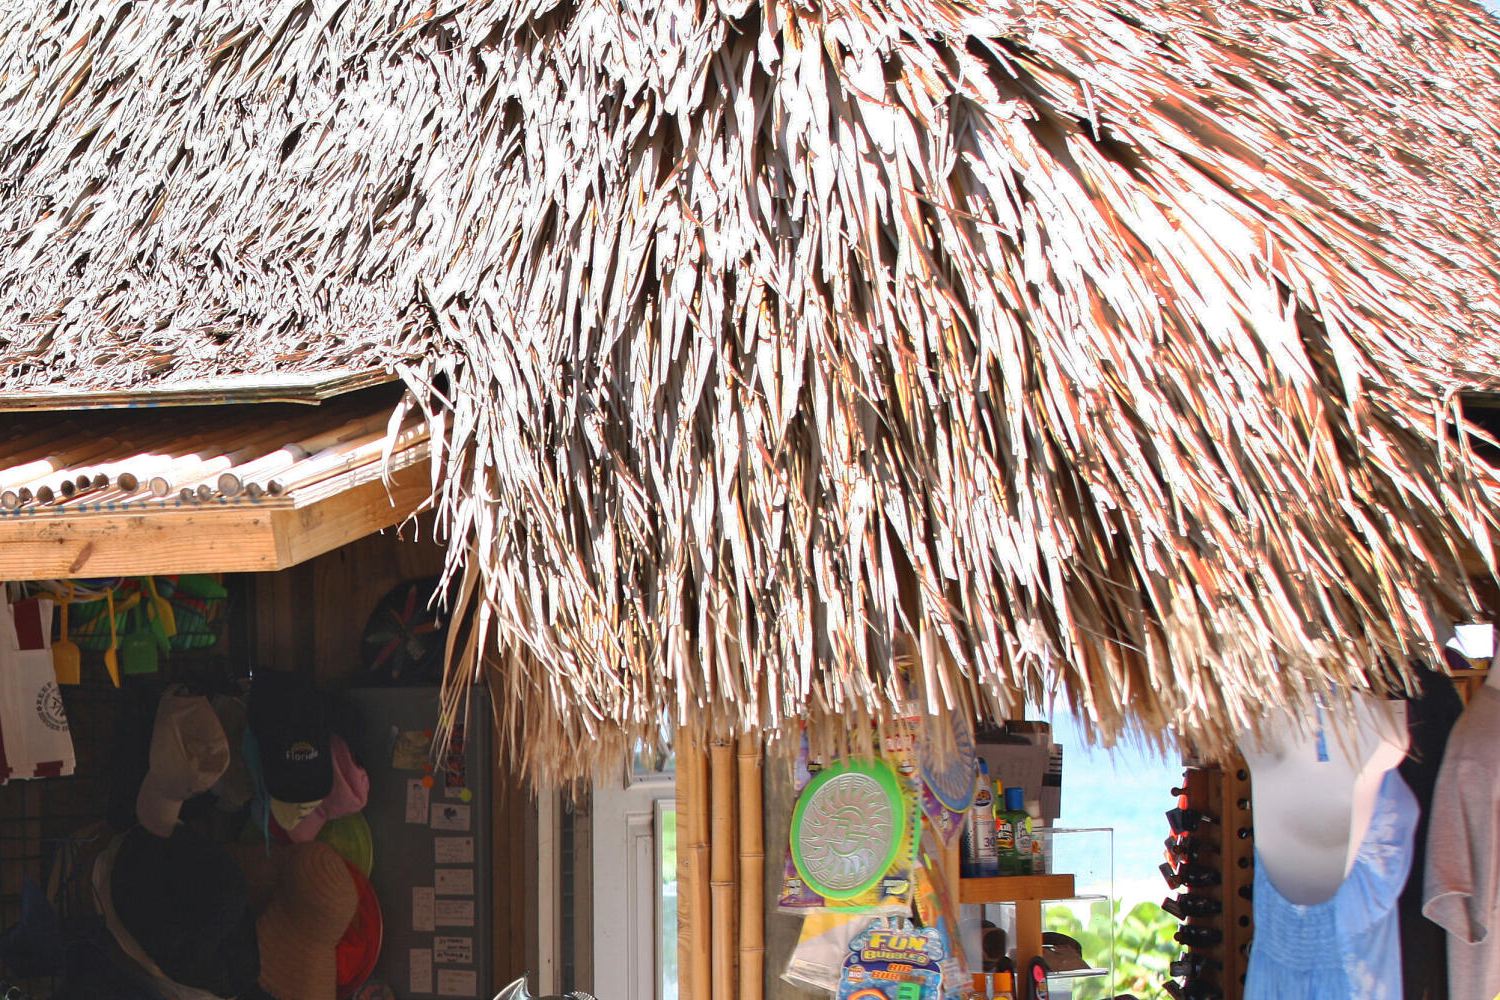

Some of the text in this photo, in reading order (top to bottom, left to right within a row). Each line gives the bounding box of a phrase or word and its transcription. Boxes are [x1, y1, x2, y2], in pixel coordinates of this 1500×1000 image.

[869, 932, 927, 951] FUN
[863, 950, 928, 964] BUBBLES
[888, 963, 913, 973] BIG
